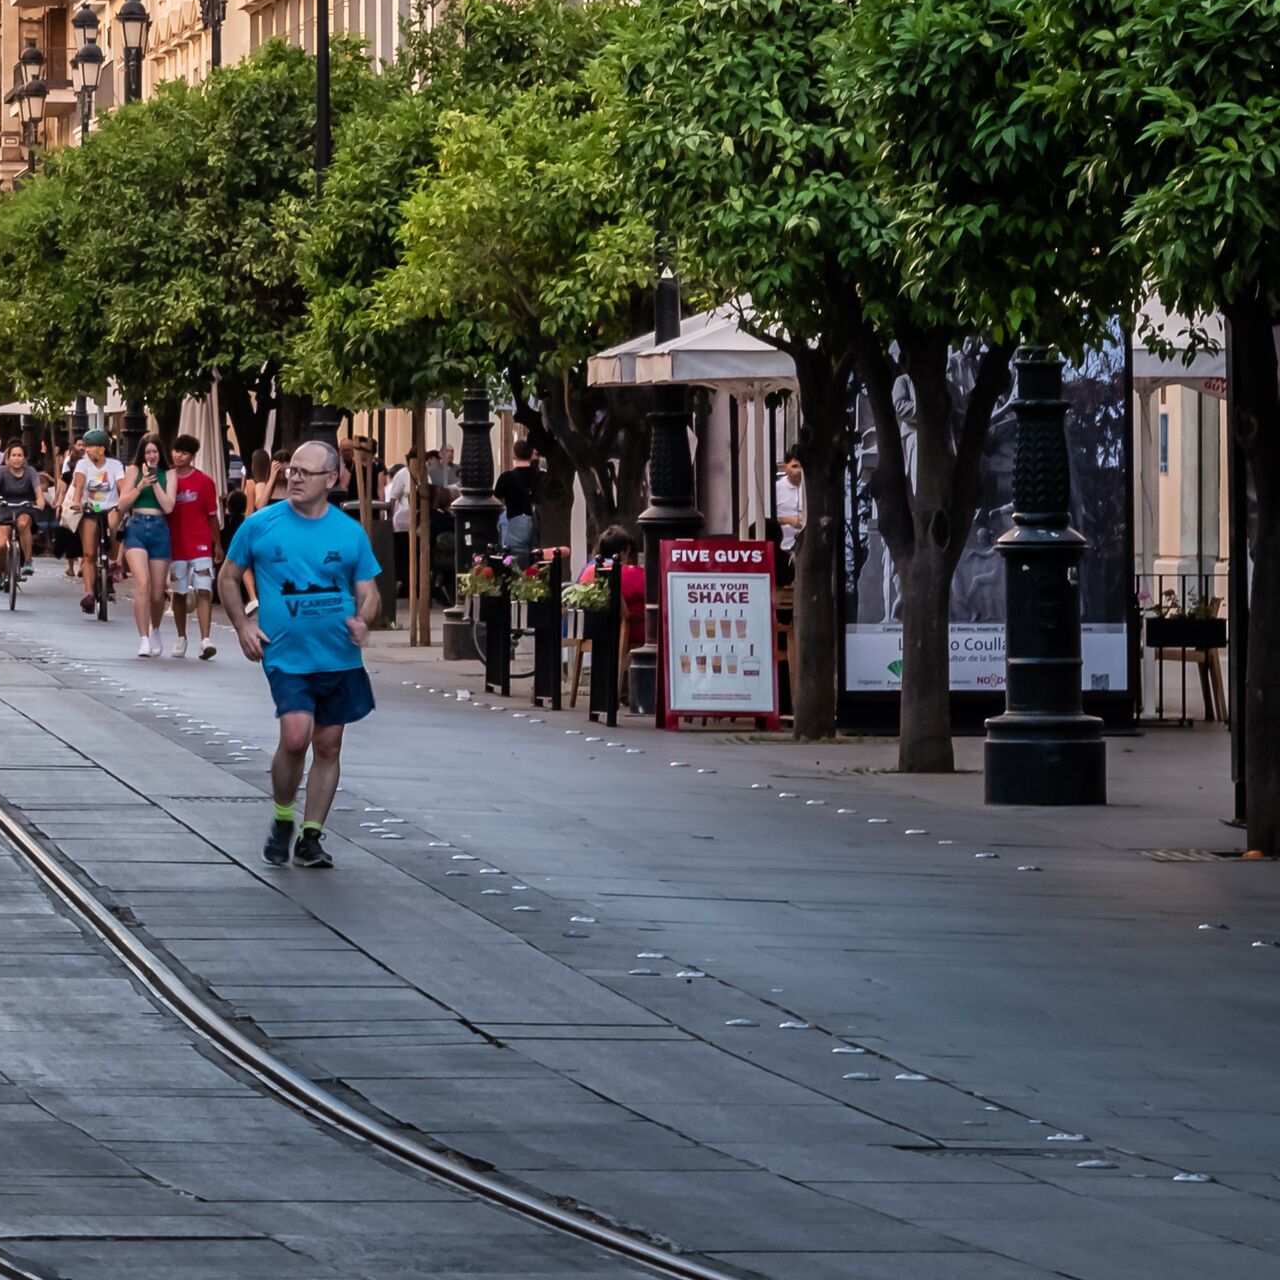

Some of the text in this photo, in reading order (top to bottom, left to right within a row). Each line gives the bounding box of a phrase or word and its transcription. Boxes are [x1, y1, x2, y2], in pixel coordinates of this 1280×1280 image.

[671, 549, 763, 563] FIVE GUYS
[687, 583, 749, 591] MAKE YOUR
[687, 591, 750, 604] SHAKE
[285, 599, 299, 618] V
